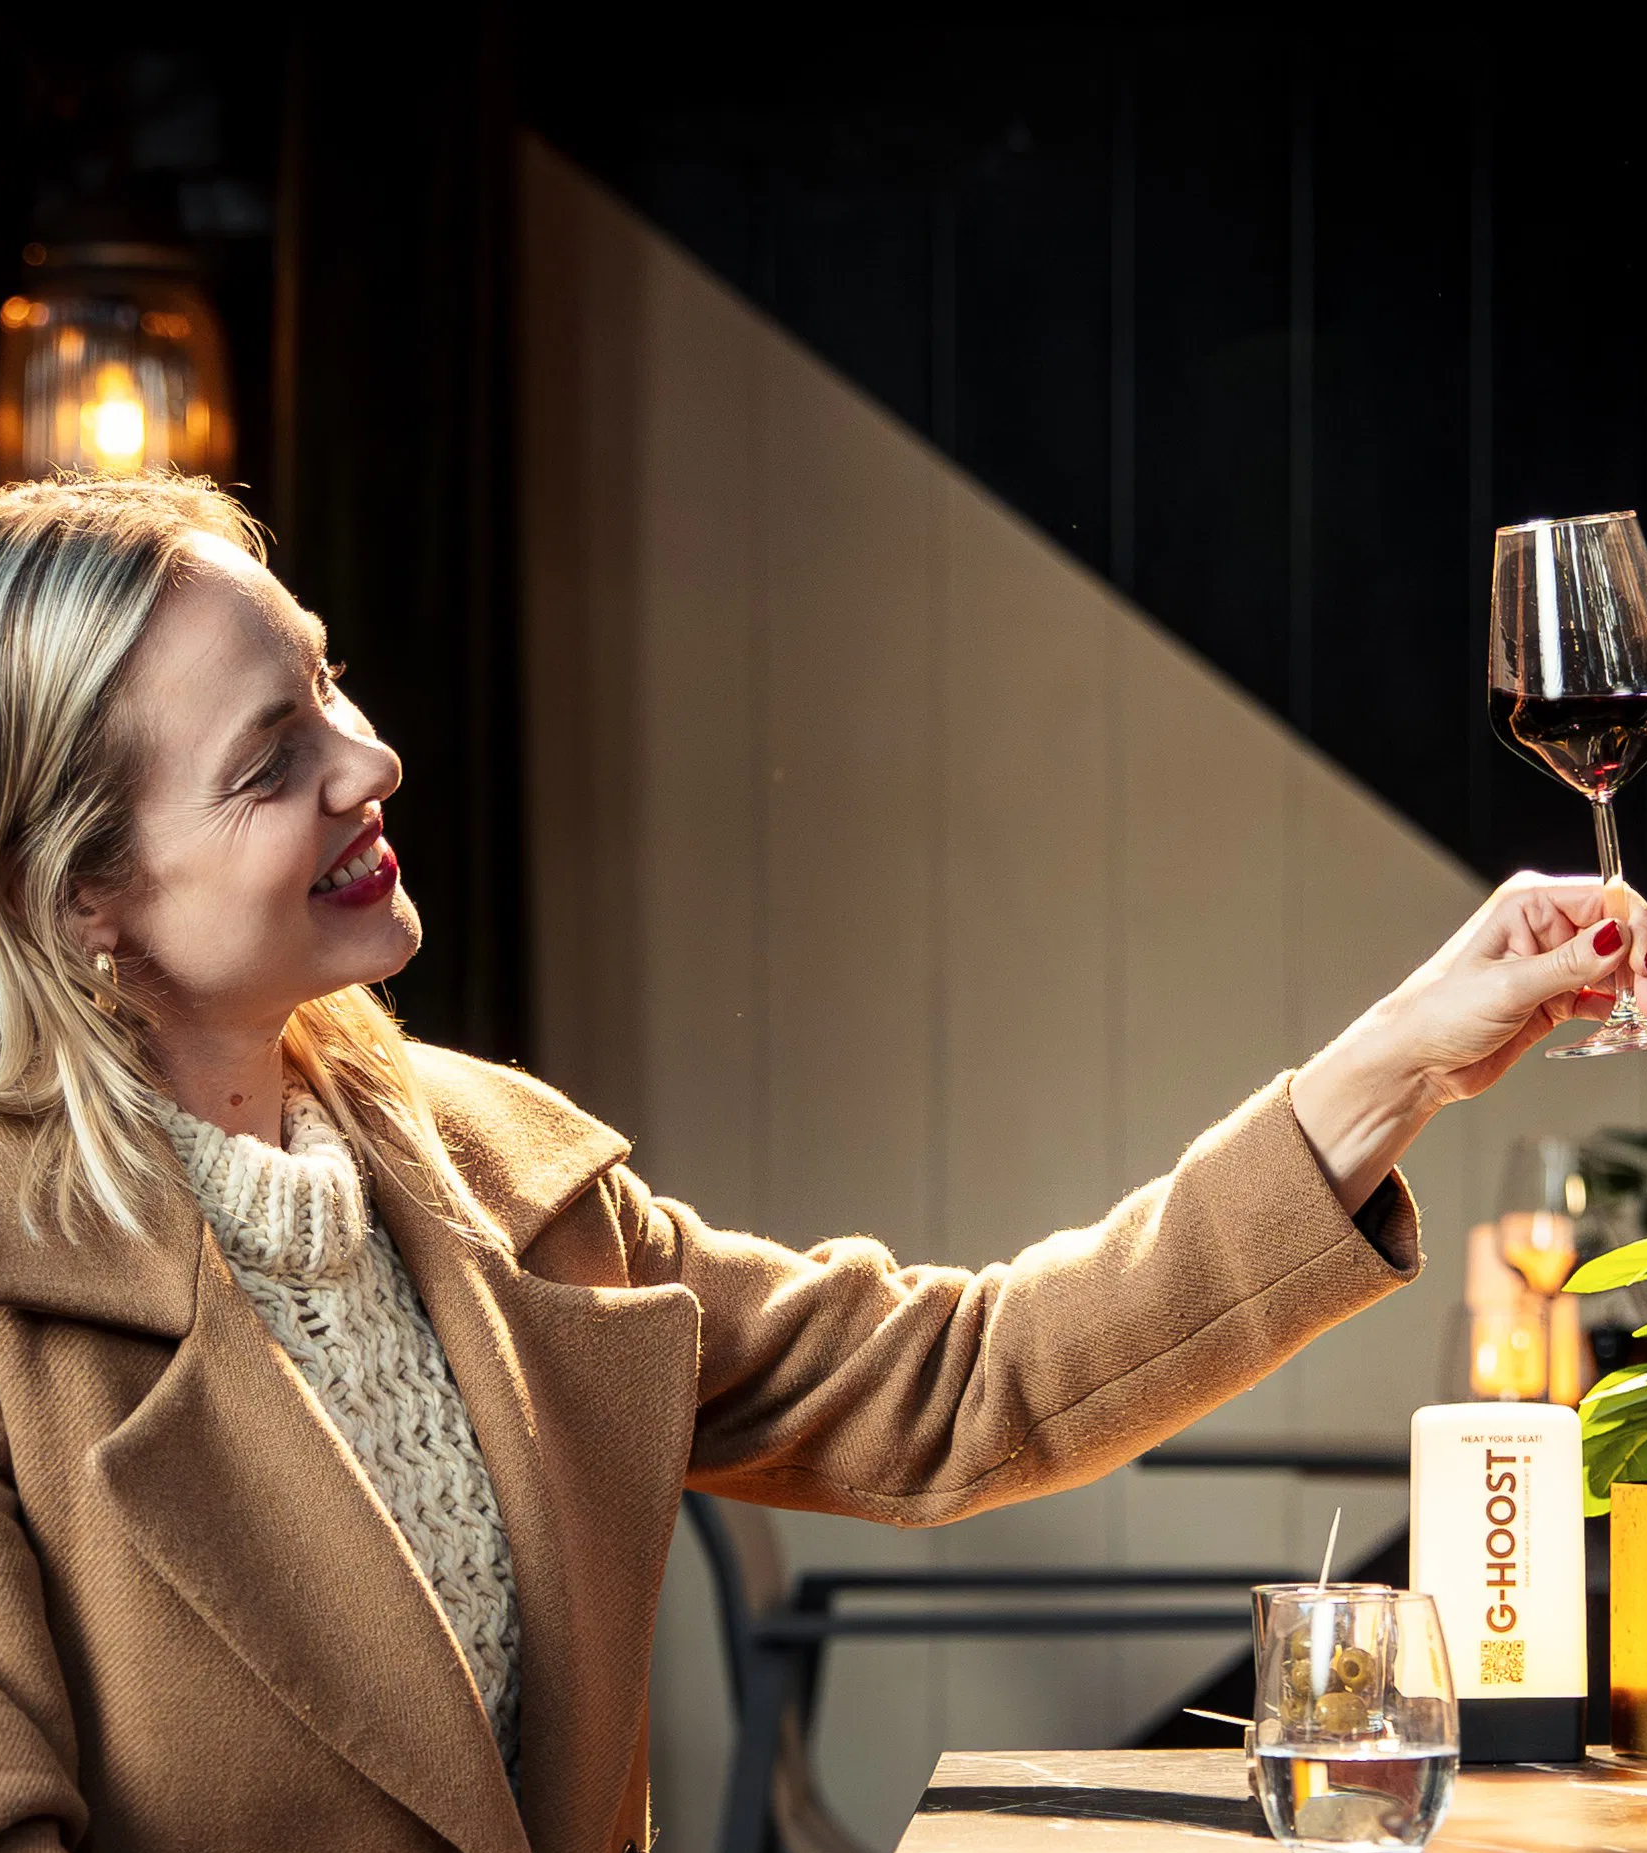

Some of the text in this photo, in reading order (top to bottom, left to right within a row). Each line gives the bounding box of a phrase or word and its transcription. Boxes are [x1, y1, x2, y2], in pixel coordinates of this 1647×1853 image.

[1461, 1434, 1542, 1443] HEAT YOUR SEAT!
[1486, 1449, 1516, 1632] G-HOOST
